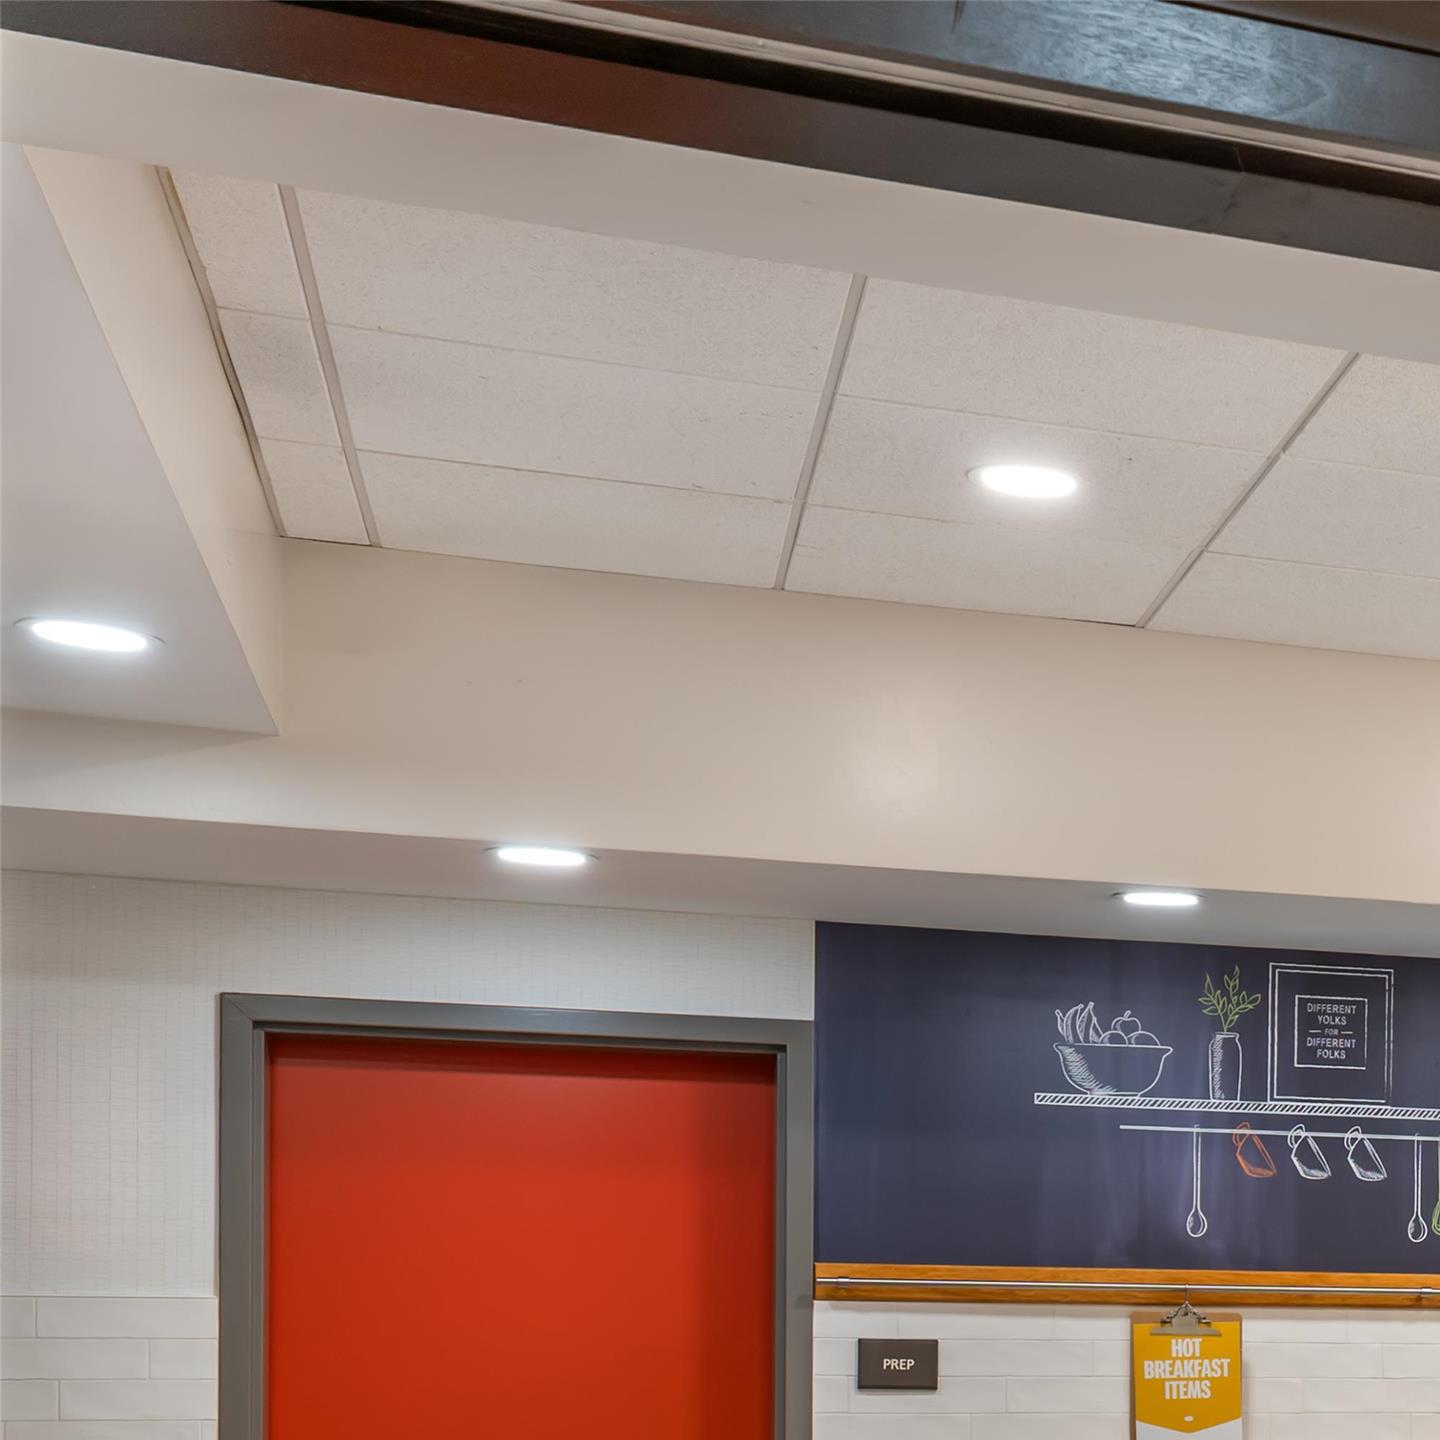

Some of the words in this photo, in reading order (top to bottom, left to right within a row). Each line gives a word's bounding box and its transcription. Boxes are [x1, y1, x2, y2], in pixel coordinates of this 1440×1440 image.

[1306, 1003, 1357, 1014] DIFFERENT
[1317, 1015, 1347, 1025] YOLKS
[1306, 1037, 1357, 1048] DIFFERENT
[1316, 1049, 1346, 1059] FOLKS
[1171, 1338, 1203, 1357] HOT
[883, 1358, 915, 1370] PREP
[1143, 1358, 1231, 1379] BREAKFAST
[1164, 1380, 1211, 1399] ITEMS
